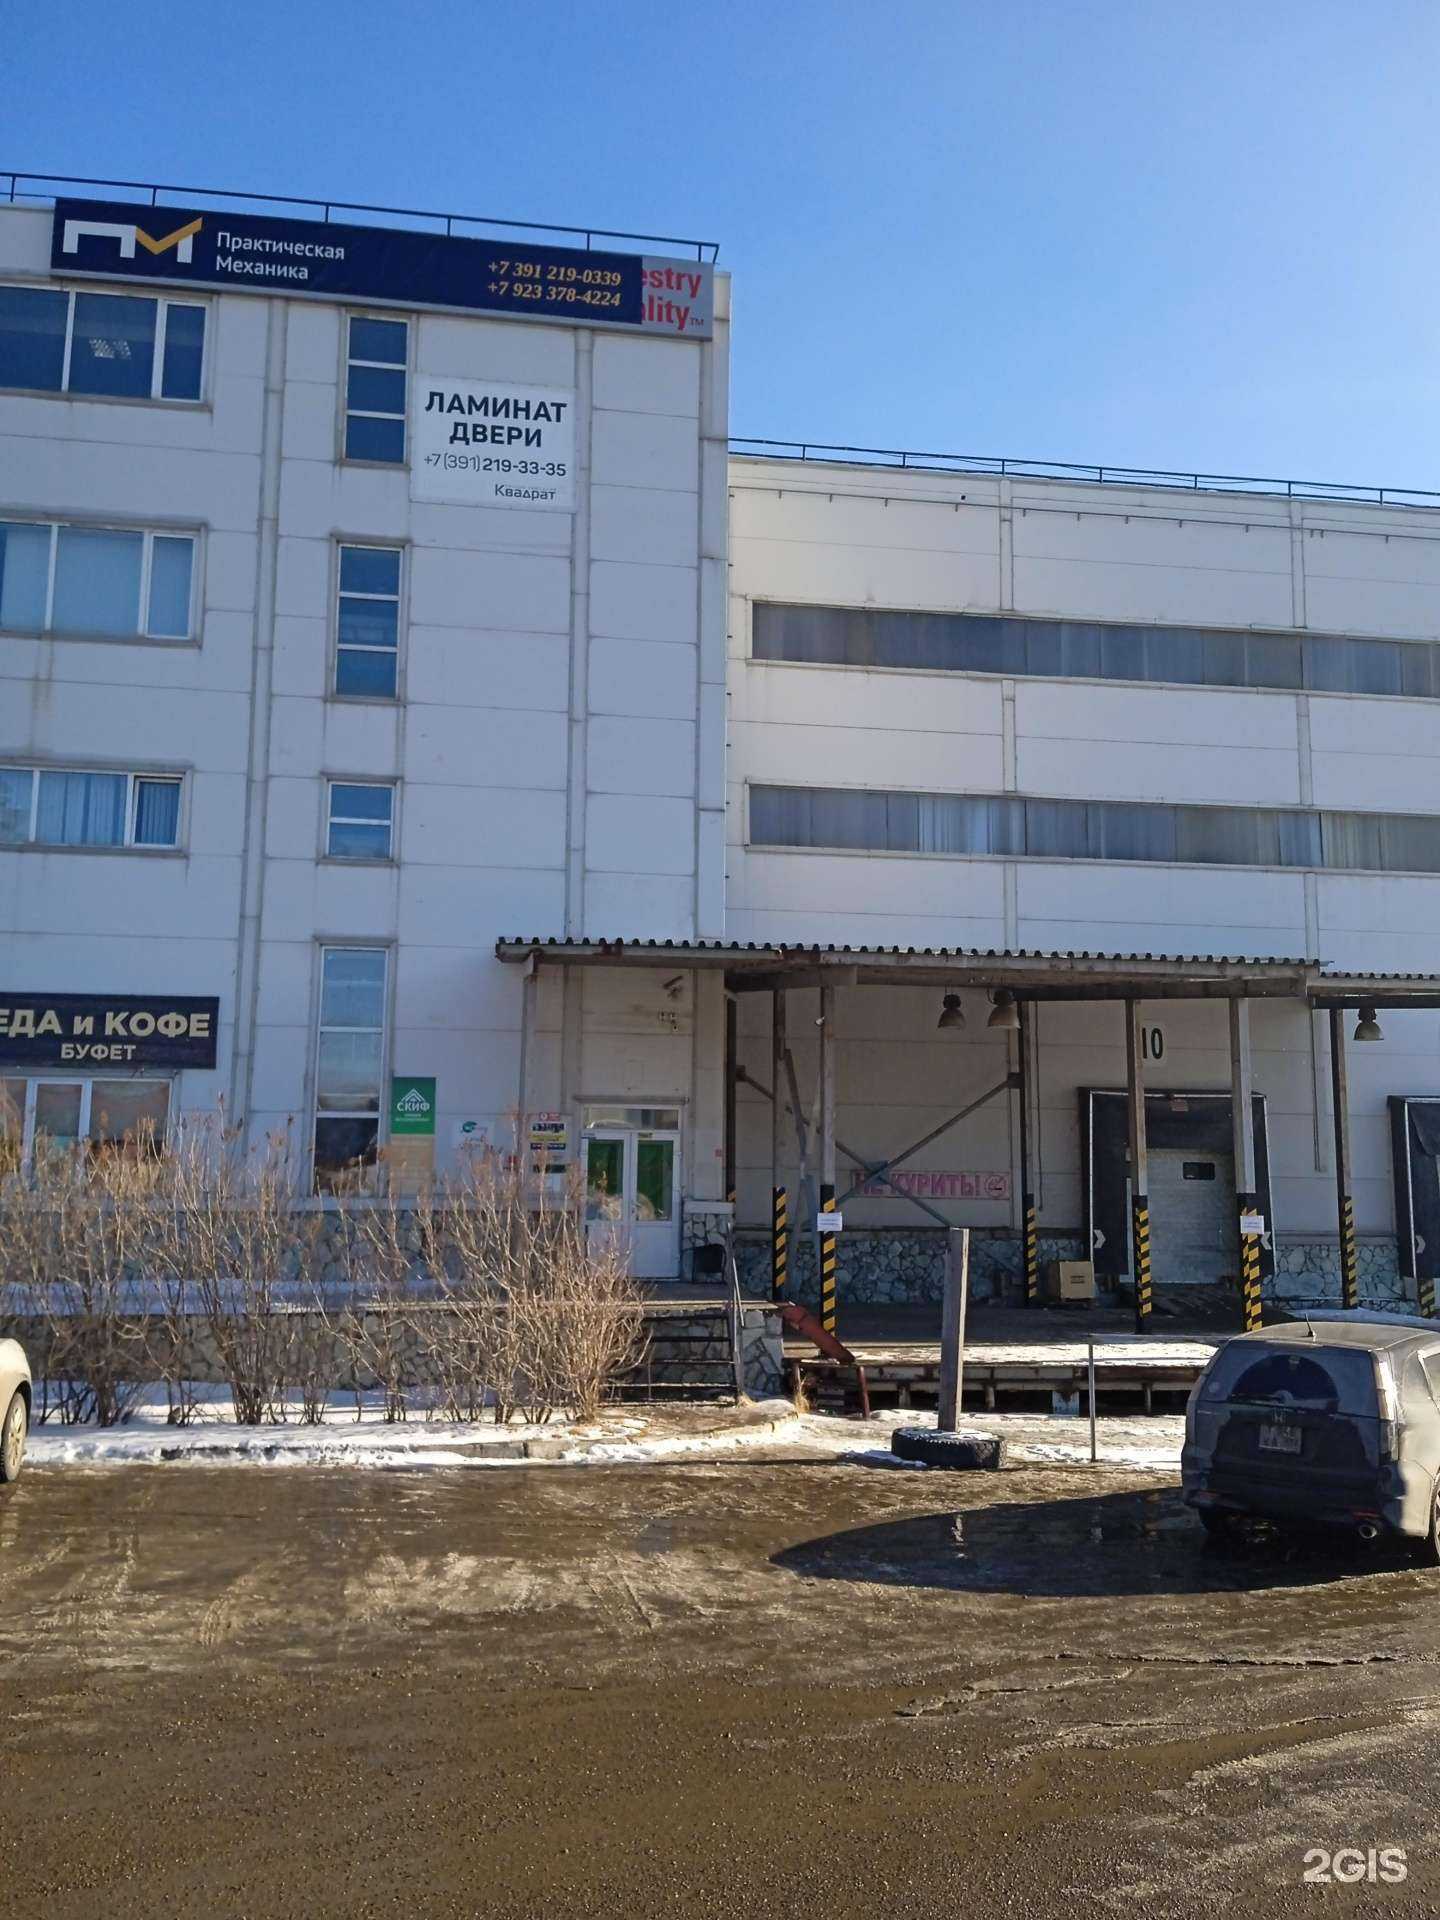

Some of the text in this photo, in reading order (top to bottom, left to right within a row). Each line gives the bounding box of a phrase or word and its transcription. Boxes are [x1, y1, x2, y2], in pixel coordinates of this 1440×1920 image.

[216, 231, 345, 260] Практическая
[215, 255, 308, 281] Механика
[488, 260, 621, 287] +7 391 219-0339
[488, 282, 621, 307] +7 923 378-4224
[642, 294, 690, 331] lity
[425, 391, 567, 423] ЛАМИНАТ
[449, 421, 542, 448] ДВЕРИ
[482, 457, 567, 477] 219-33-35
[495, 484, 556, 501] Квадрат
[73, 1015, 94, 1036] и
[104, 1011, 210, 1038] КОФЕ
[61, 1043, 136, 1060] БУФЕТ
[1142, 1027, 1163, 1060] 10
[396, 1101, 430, 1112] СКИФ
